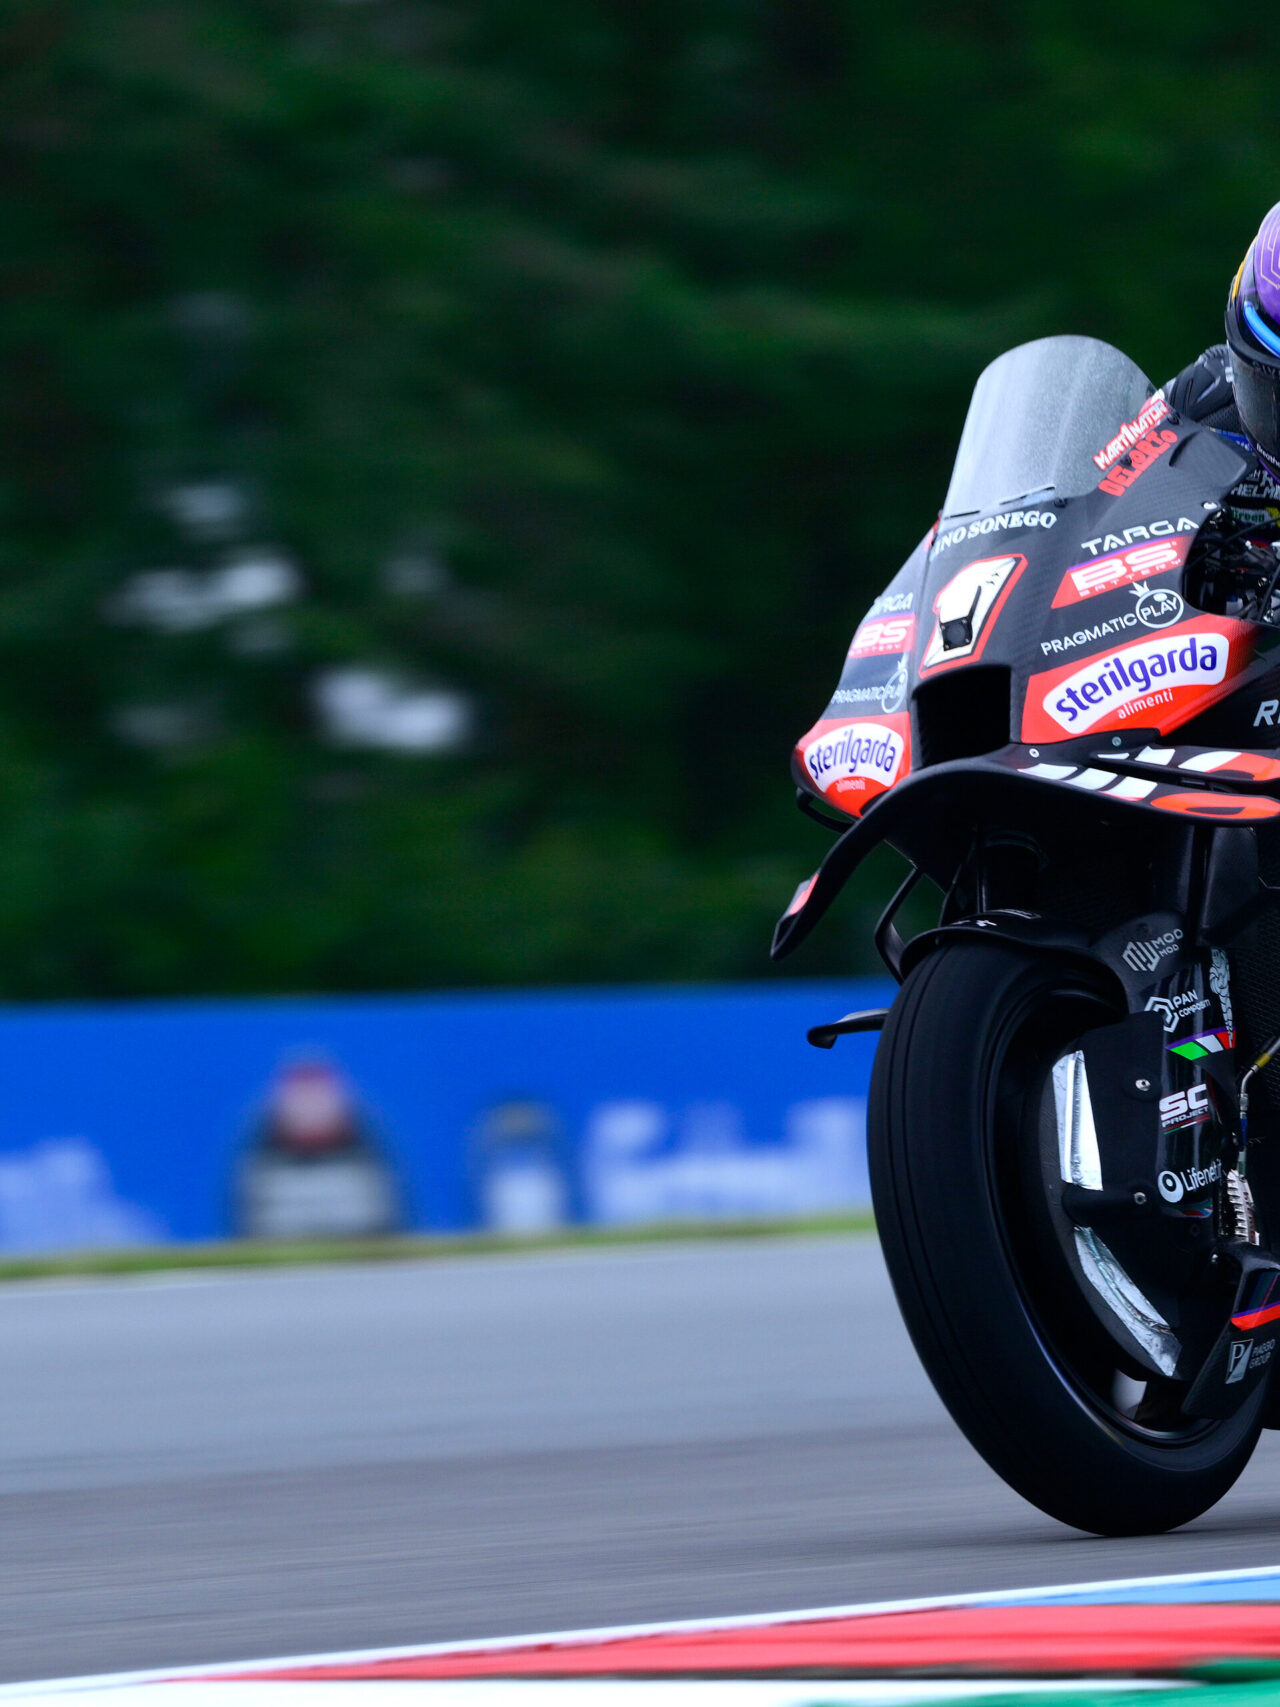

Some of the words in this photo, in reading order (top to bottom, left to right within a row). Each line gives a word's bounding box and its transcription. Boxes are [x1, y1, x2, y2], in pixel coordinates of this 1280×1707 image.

[967, 511, 1058, 540] SONEGO
[1081, 517, 1200, 555] TARGA
[1070, 542, 1178, 592] BS
[1079, 558, 1182, 597] BATTERY
[853, 619, 914, 649] BS
[919, 554, 1028, 678] 1
[1041, 613, 1138, 656] PRAGMATIC
[1140, 597, 1178, 621] PLAY
[1056, 637, 1217, 721] sterilgarda
[1116, 688, 1174, 719] alimenti
[809, 729, 896, 779] sterilgarda
[1151, 929, 1184, 949] MOD
[1159, 944, 1180, 957] MOD
[1172, 989, 1199, 1008] PAN
[1159, 1084, 1208, 1121] SC
[1162, 1106, 1209, 1127] PROJECT
